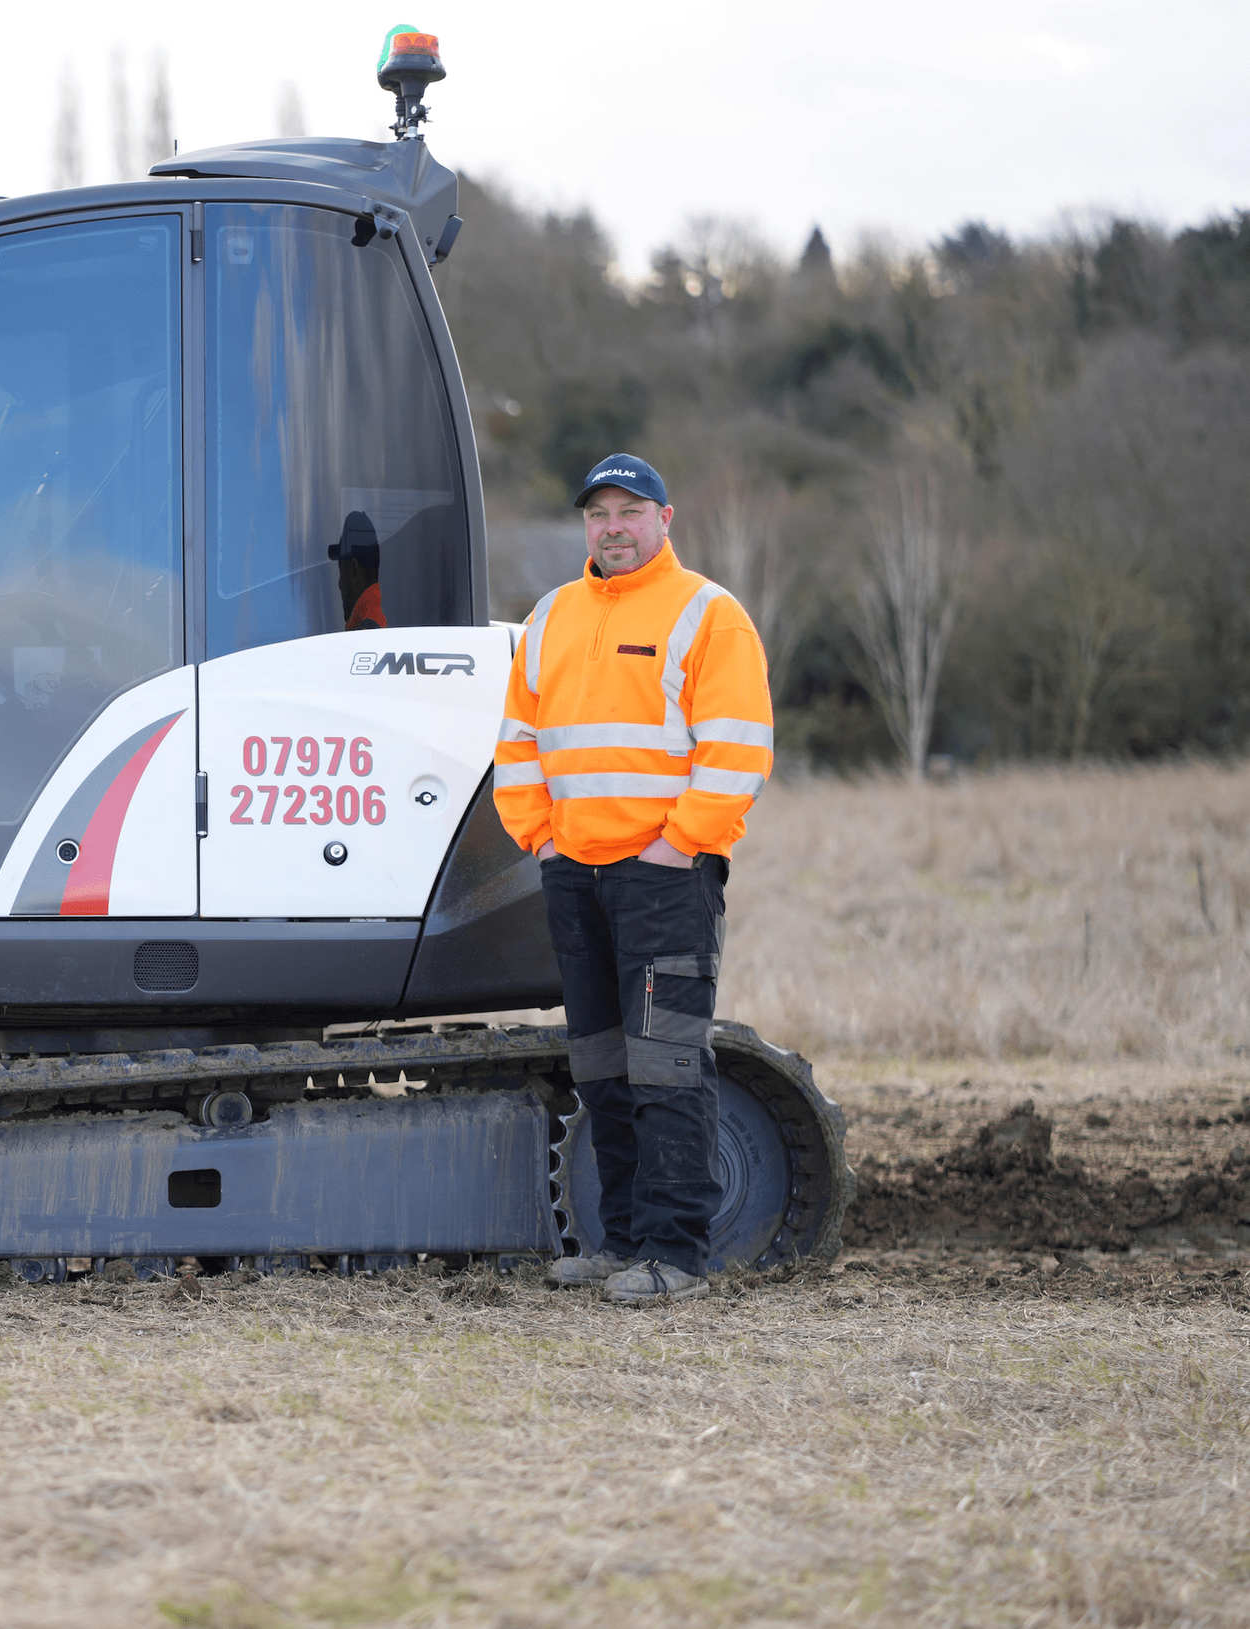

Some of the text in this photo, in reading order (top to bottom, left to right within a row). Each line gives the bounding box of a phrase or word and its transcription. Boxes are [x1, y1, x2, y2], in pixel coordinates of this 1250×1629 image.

[350, 652, 475, 676] 8MCR
[243, 736, 373, 776] 07976
[229, 785, 386, 825] 272306
